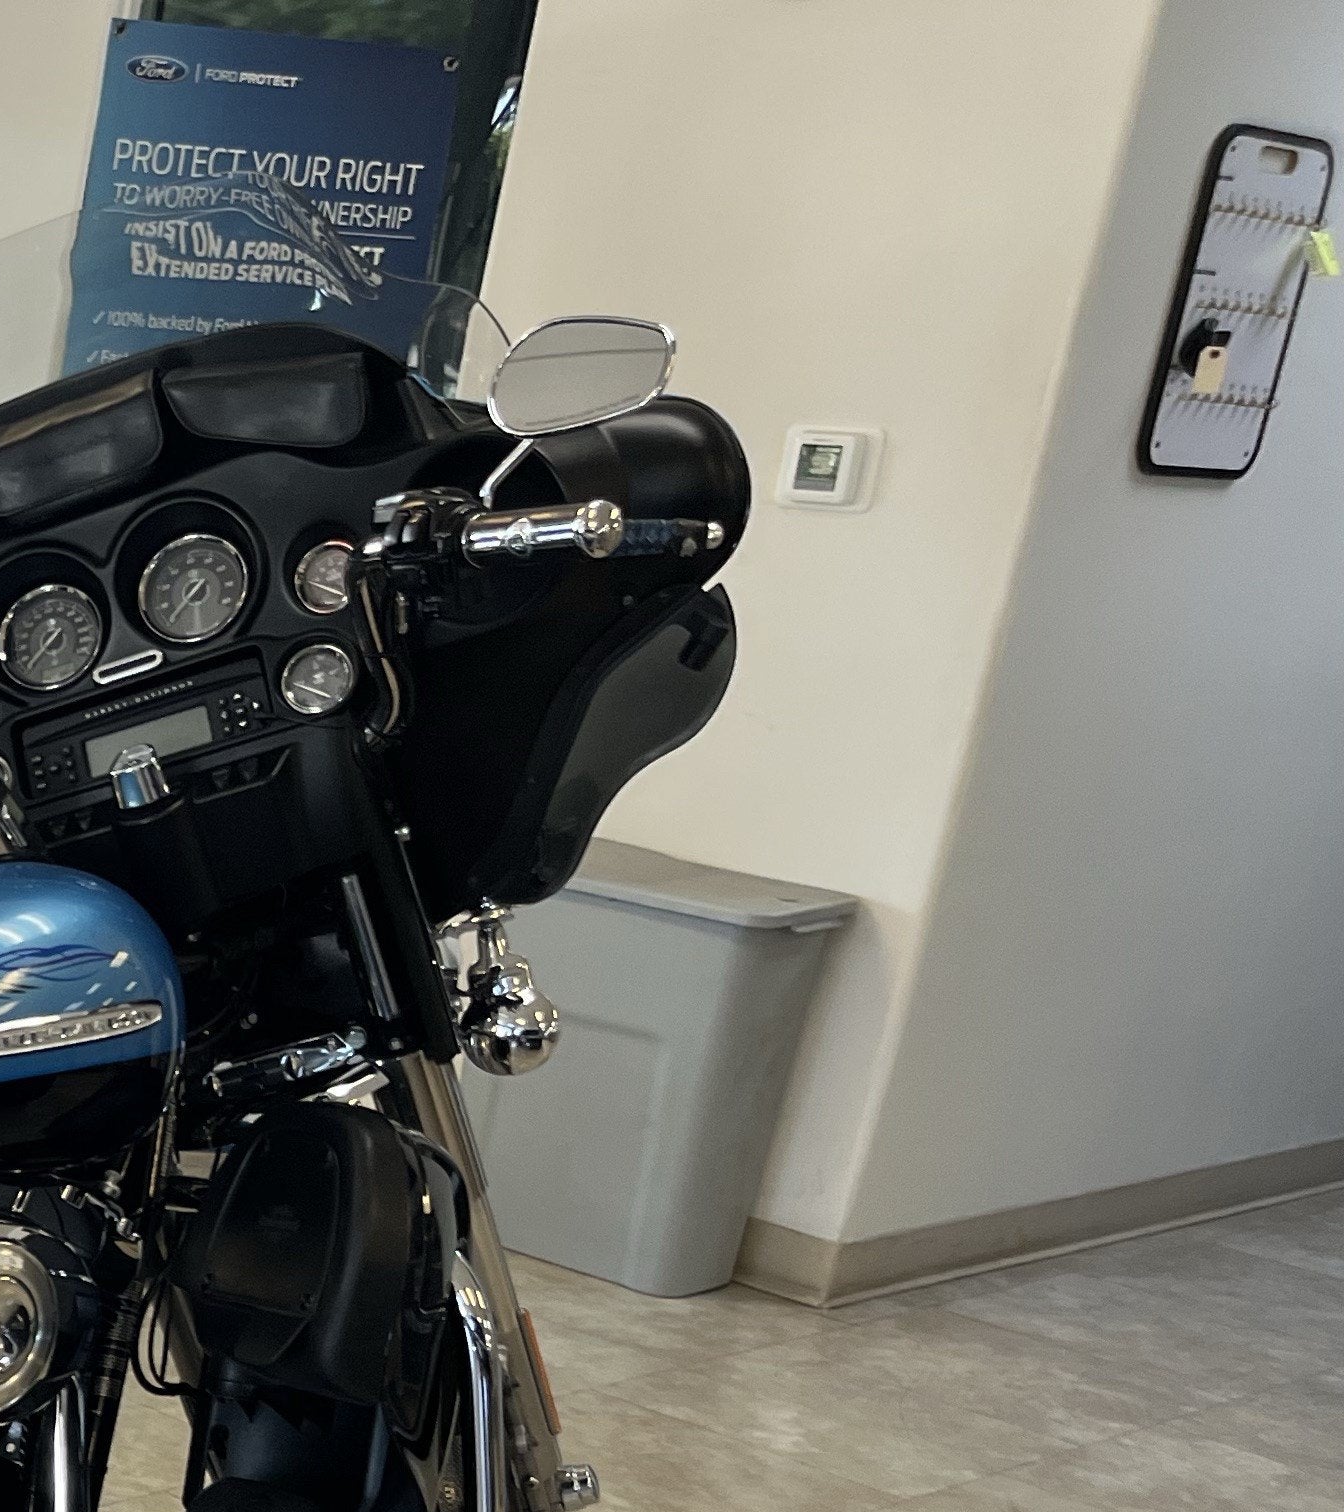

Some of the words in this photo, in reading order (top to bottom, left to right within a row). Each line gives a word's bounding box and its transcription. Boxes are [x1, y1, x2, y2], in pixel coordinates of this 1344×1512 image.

[134, 57, 178, 81] Ford
[113, 138, 247, 179] PROTECT
[254, 150, 331, 189] YOUR
[335, 157, 425, 196] RIGHT
[113, 183, 141, 205] TO
[124, 220, 189, 254] INSIST
[191, 221, 222, 259] ON
[223, 240, 238, 259] A
[242, 241, 292, 261] FORD
[130, 241, 234, 280] EXTENDED
[235, 263, 313, 287] SERVICE
[148, 313, 195, 331] backed
[196, 315, 213, 335] by
